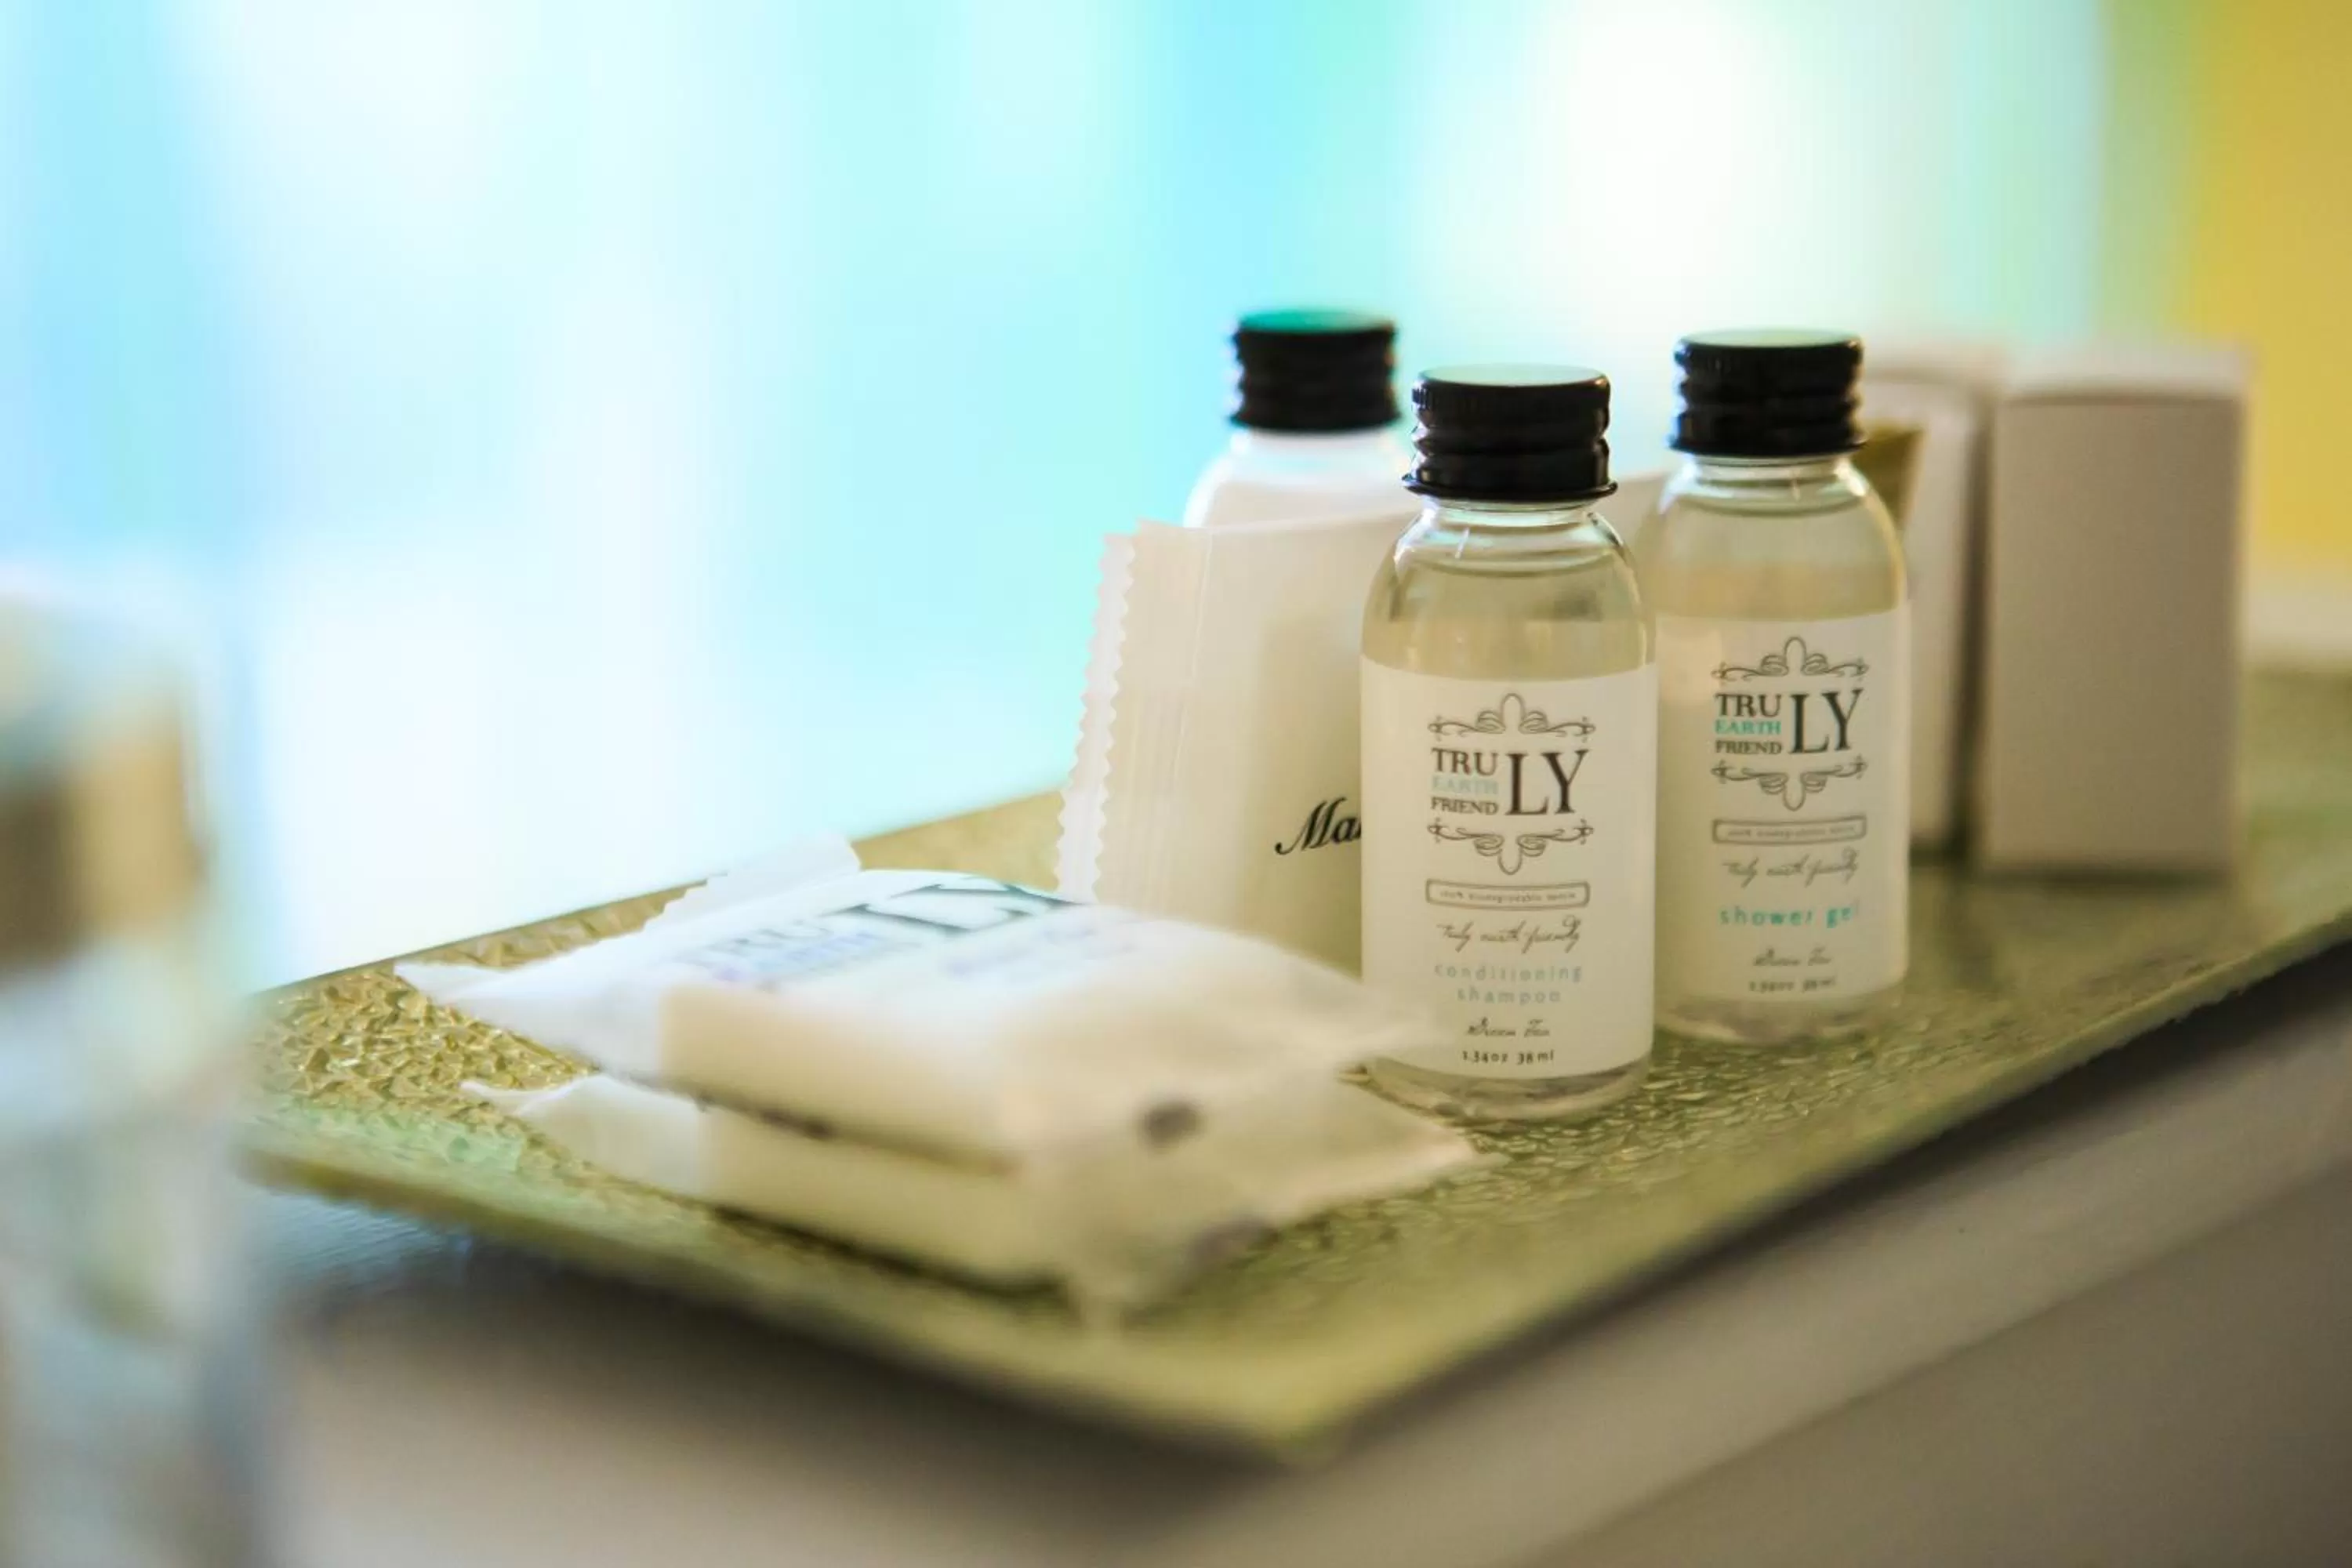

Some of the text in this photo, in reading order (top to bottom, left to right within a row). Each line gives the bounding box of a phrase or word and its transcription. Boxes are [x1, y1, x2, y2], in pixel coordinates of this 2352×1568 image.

[1714, 688, 1864, 754] TRU LY
[1715, 719, 1781, 735] EARTH
[1715, 739, 1782, 755] FRIEND
[1431, 747, 1589, 815] TRU LY
[1430, 797, 1498, 815] FRIEND
[1719, 905, 1813, 926] shower
[1434, 964, 1582, 983] conditioning
[1457, 985, 1562, 1005] shampoo
